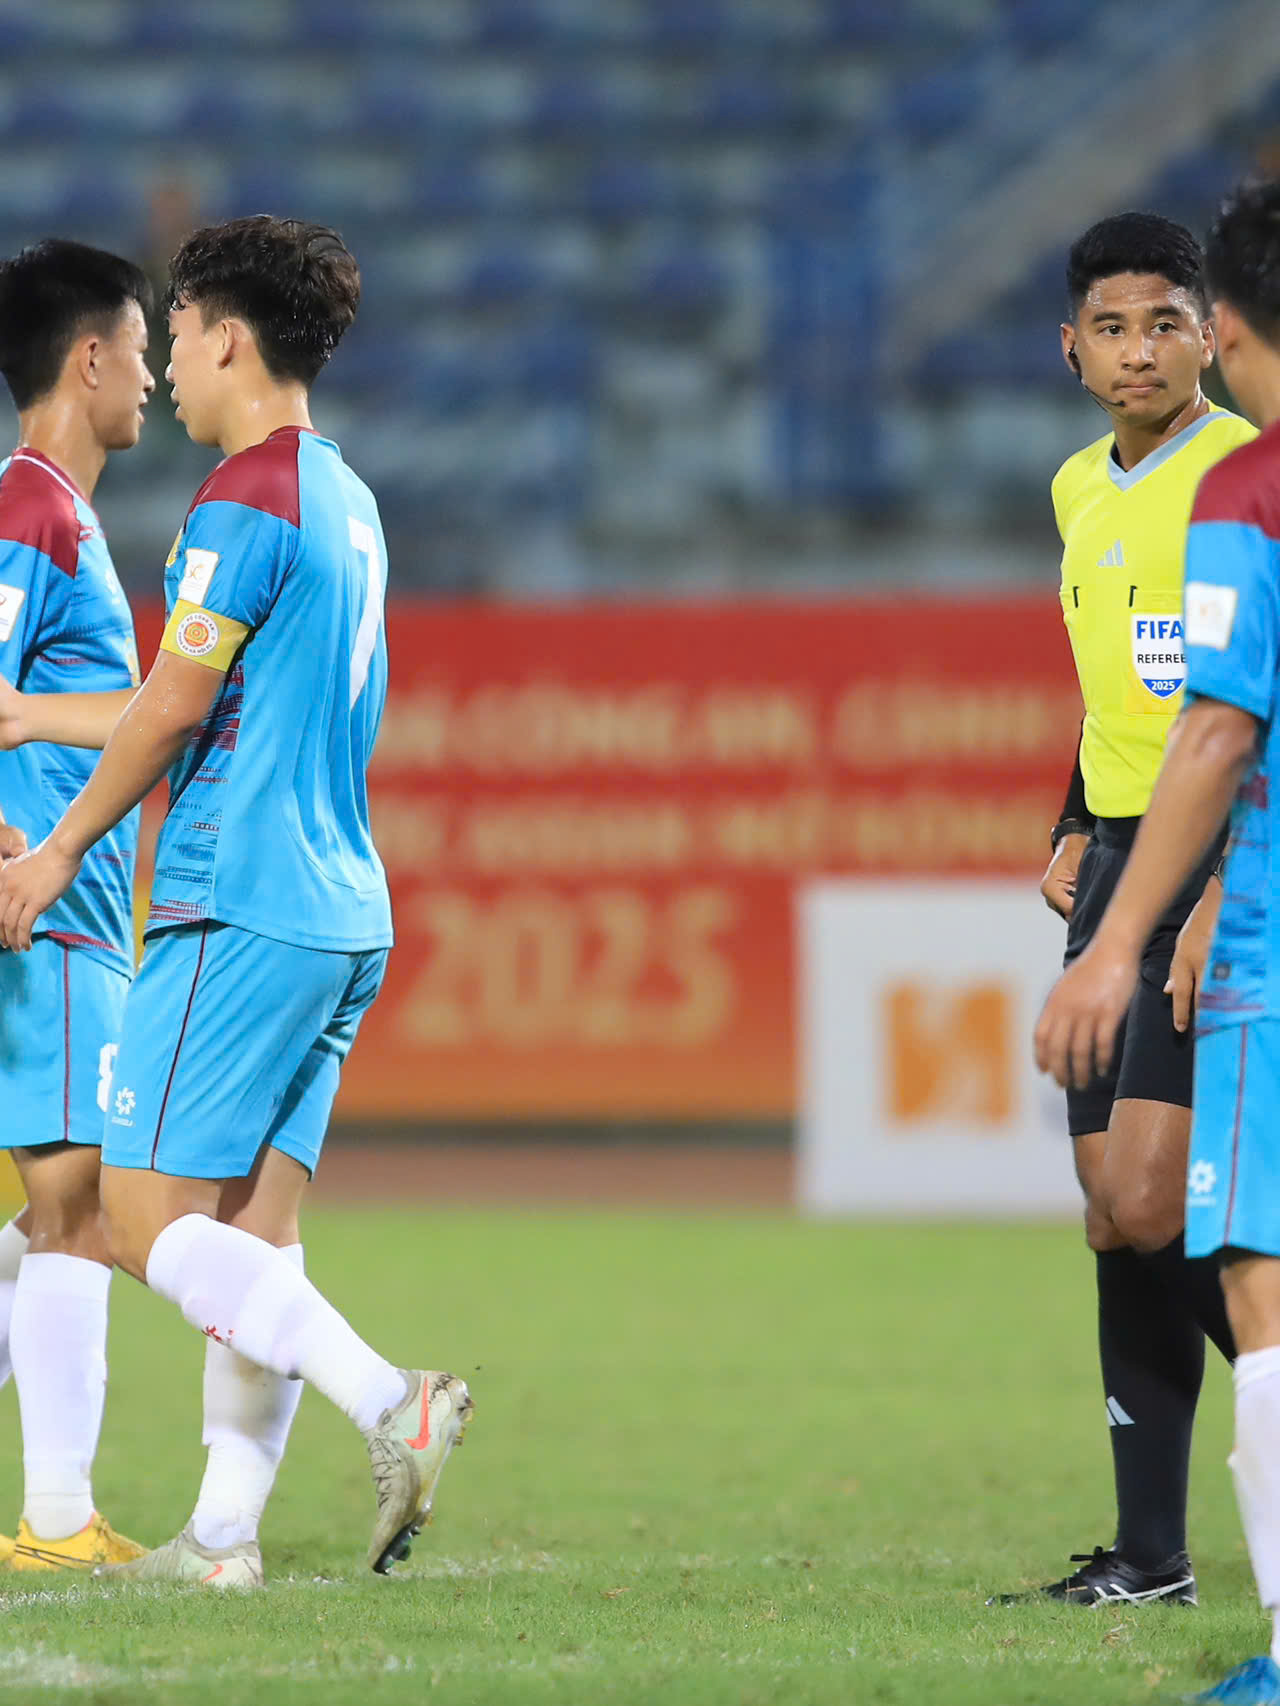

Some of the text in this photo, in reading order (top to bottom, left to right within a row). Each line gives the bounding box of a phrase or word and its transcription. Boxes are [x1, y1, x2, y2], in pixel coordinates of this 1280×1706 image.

[347, 515, 383, 712] 7
[1136, 620, 1184, 639] FIFA
[1137, 653, 1187, 664] REFEREE
[1151, 680, 1176, 691] 2025
[402, 886, 736, 1045] 2025
